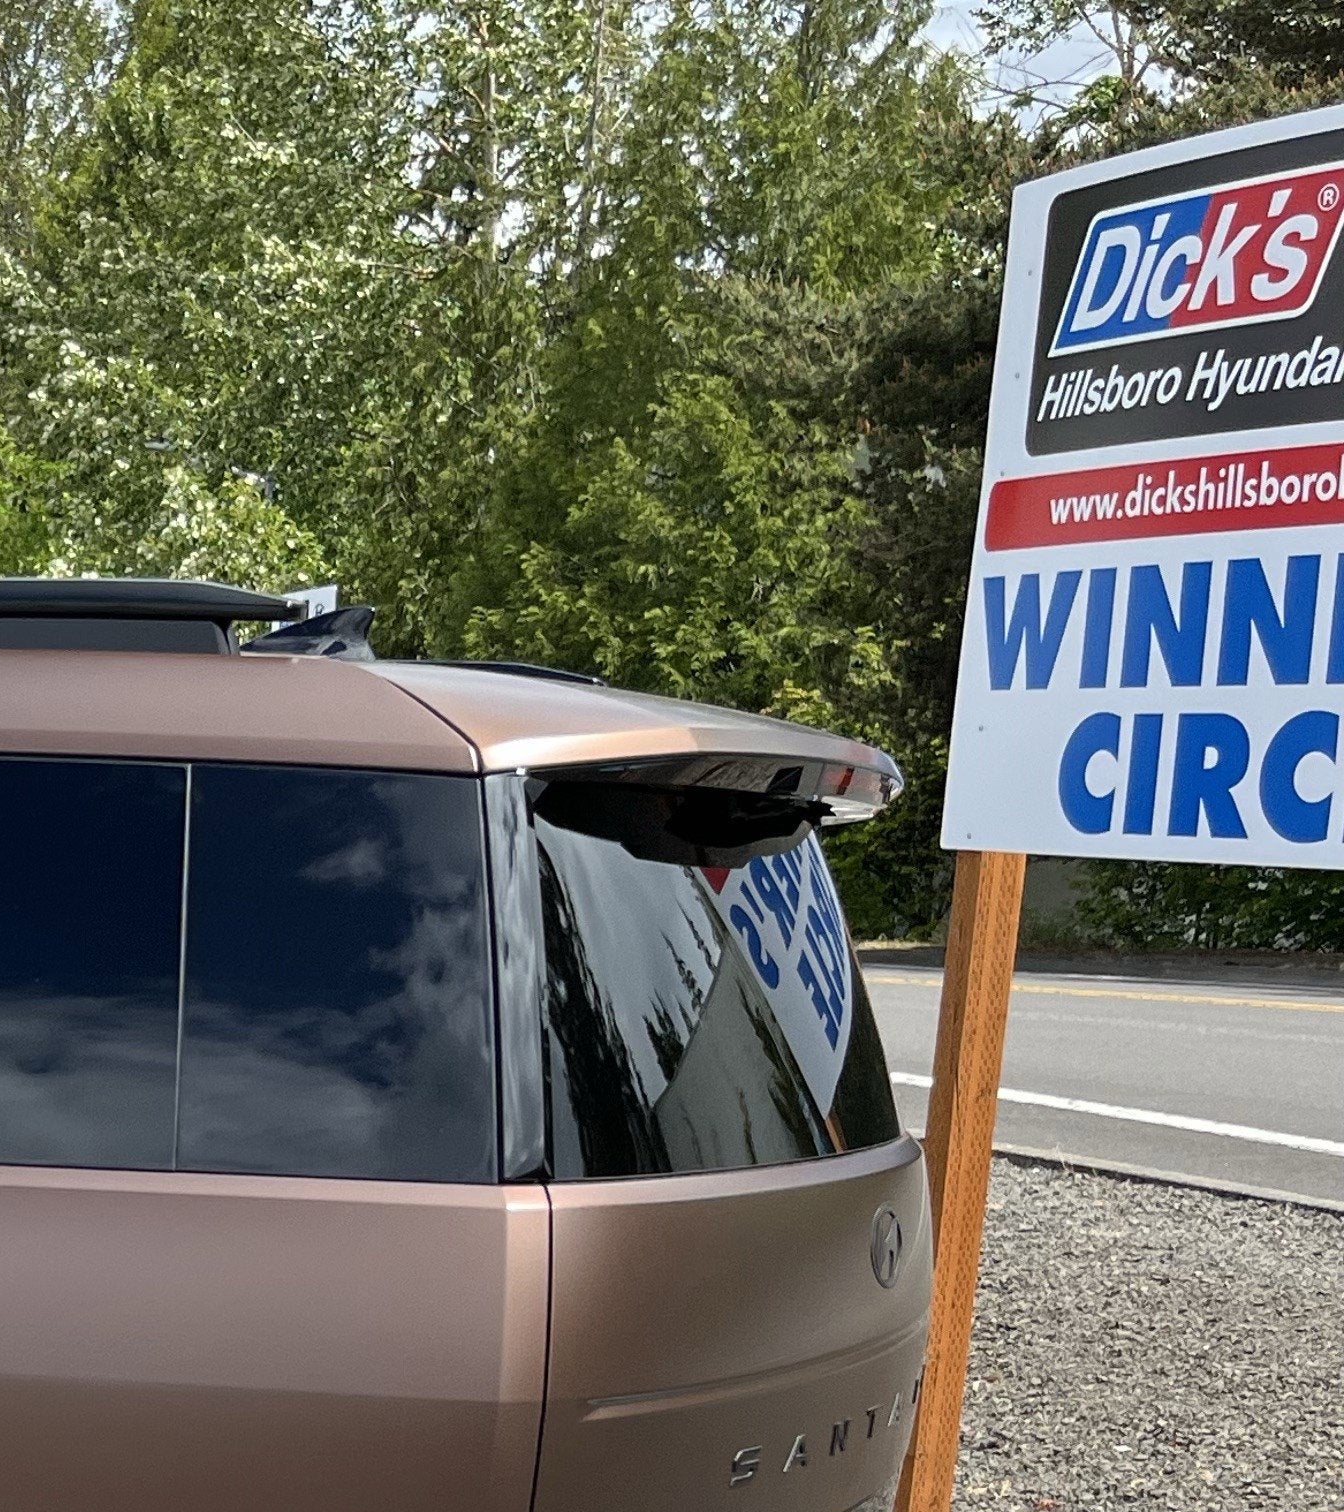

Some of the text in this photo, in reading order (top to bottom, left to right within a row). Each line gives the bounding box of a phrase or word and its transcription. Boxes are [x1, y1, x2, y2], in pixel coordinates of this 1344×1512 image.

[1036, 364, 1182, 422] Hillsboro
[983, 552, 1344, 691] WINN
[1058, 710, 1344, 844] CIRC
[730, 1391, 904, 1488] SANTA
